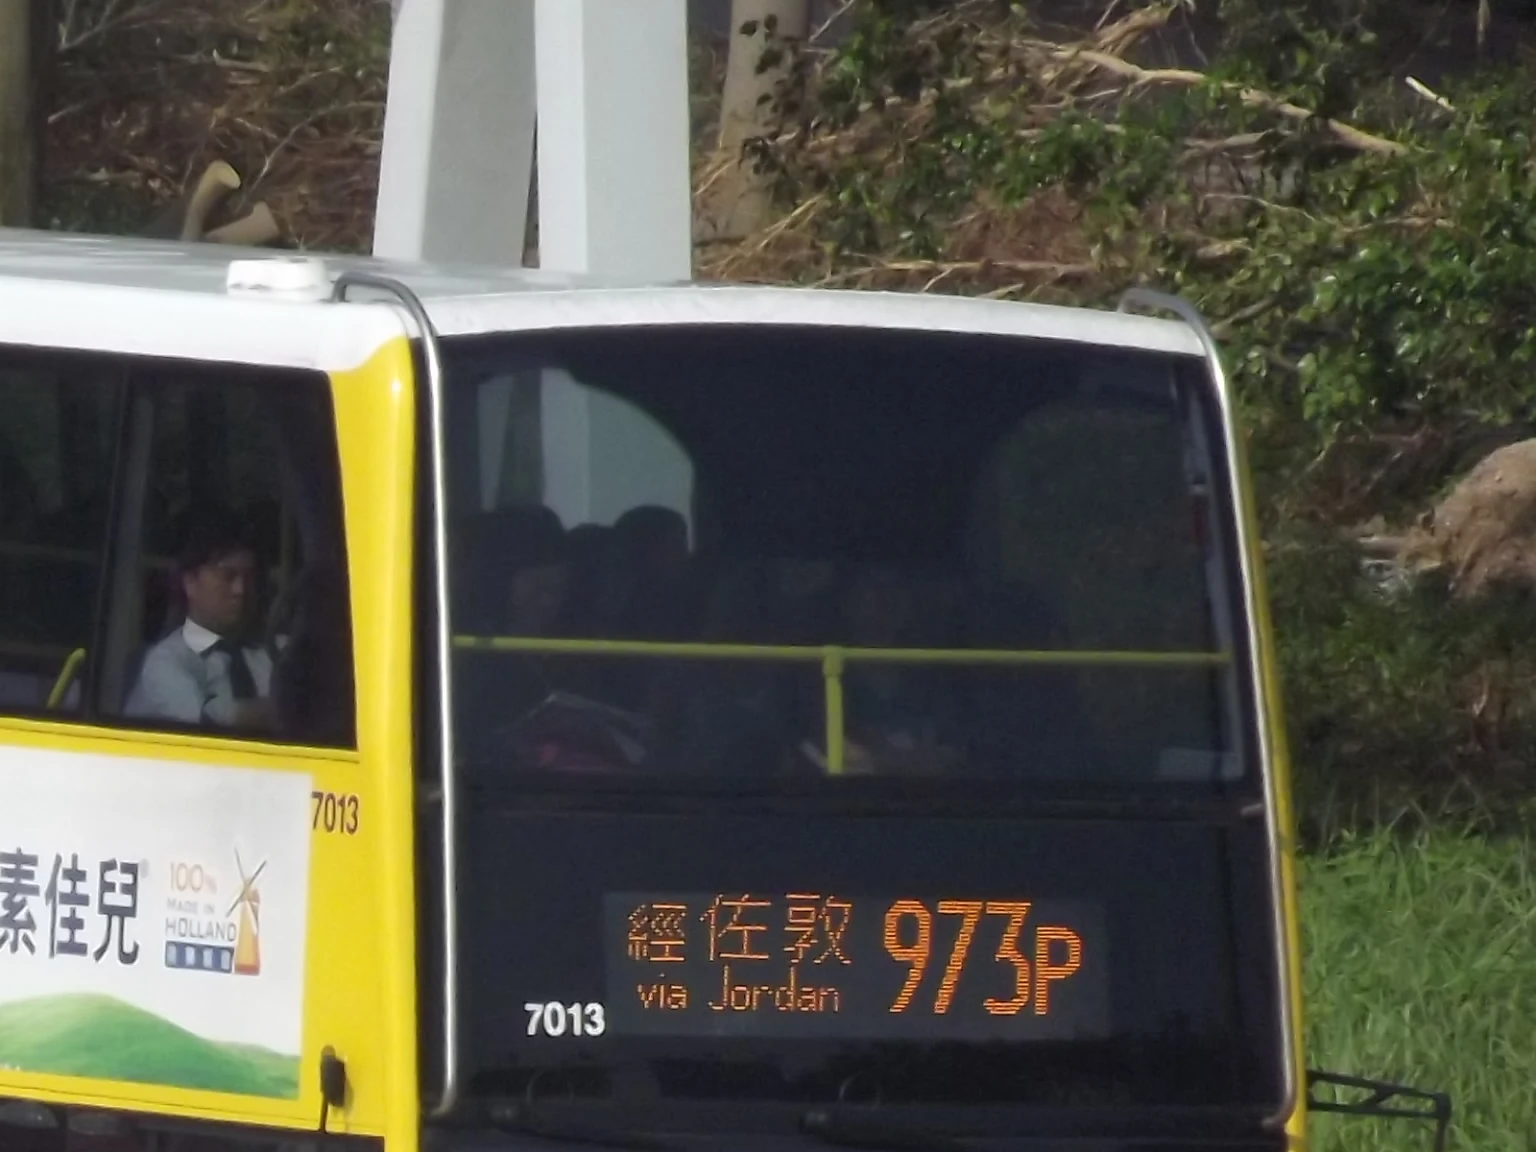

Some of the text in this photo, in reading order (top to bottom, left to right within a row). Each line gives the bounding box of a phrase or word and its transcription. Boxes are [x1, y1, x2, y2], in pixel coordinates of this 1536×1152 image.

[310, 791, 359, 835] 7013
[165, 917, 238, 942] HOLLAND
[627, 893, 853, 964] 經佐敦
[883, 899, 1083, 1016] 973P
[638, 964, 840, 1012] via Jordan
[524, 1001, 606, 1037] 7013
